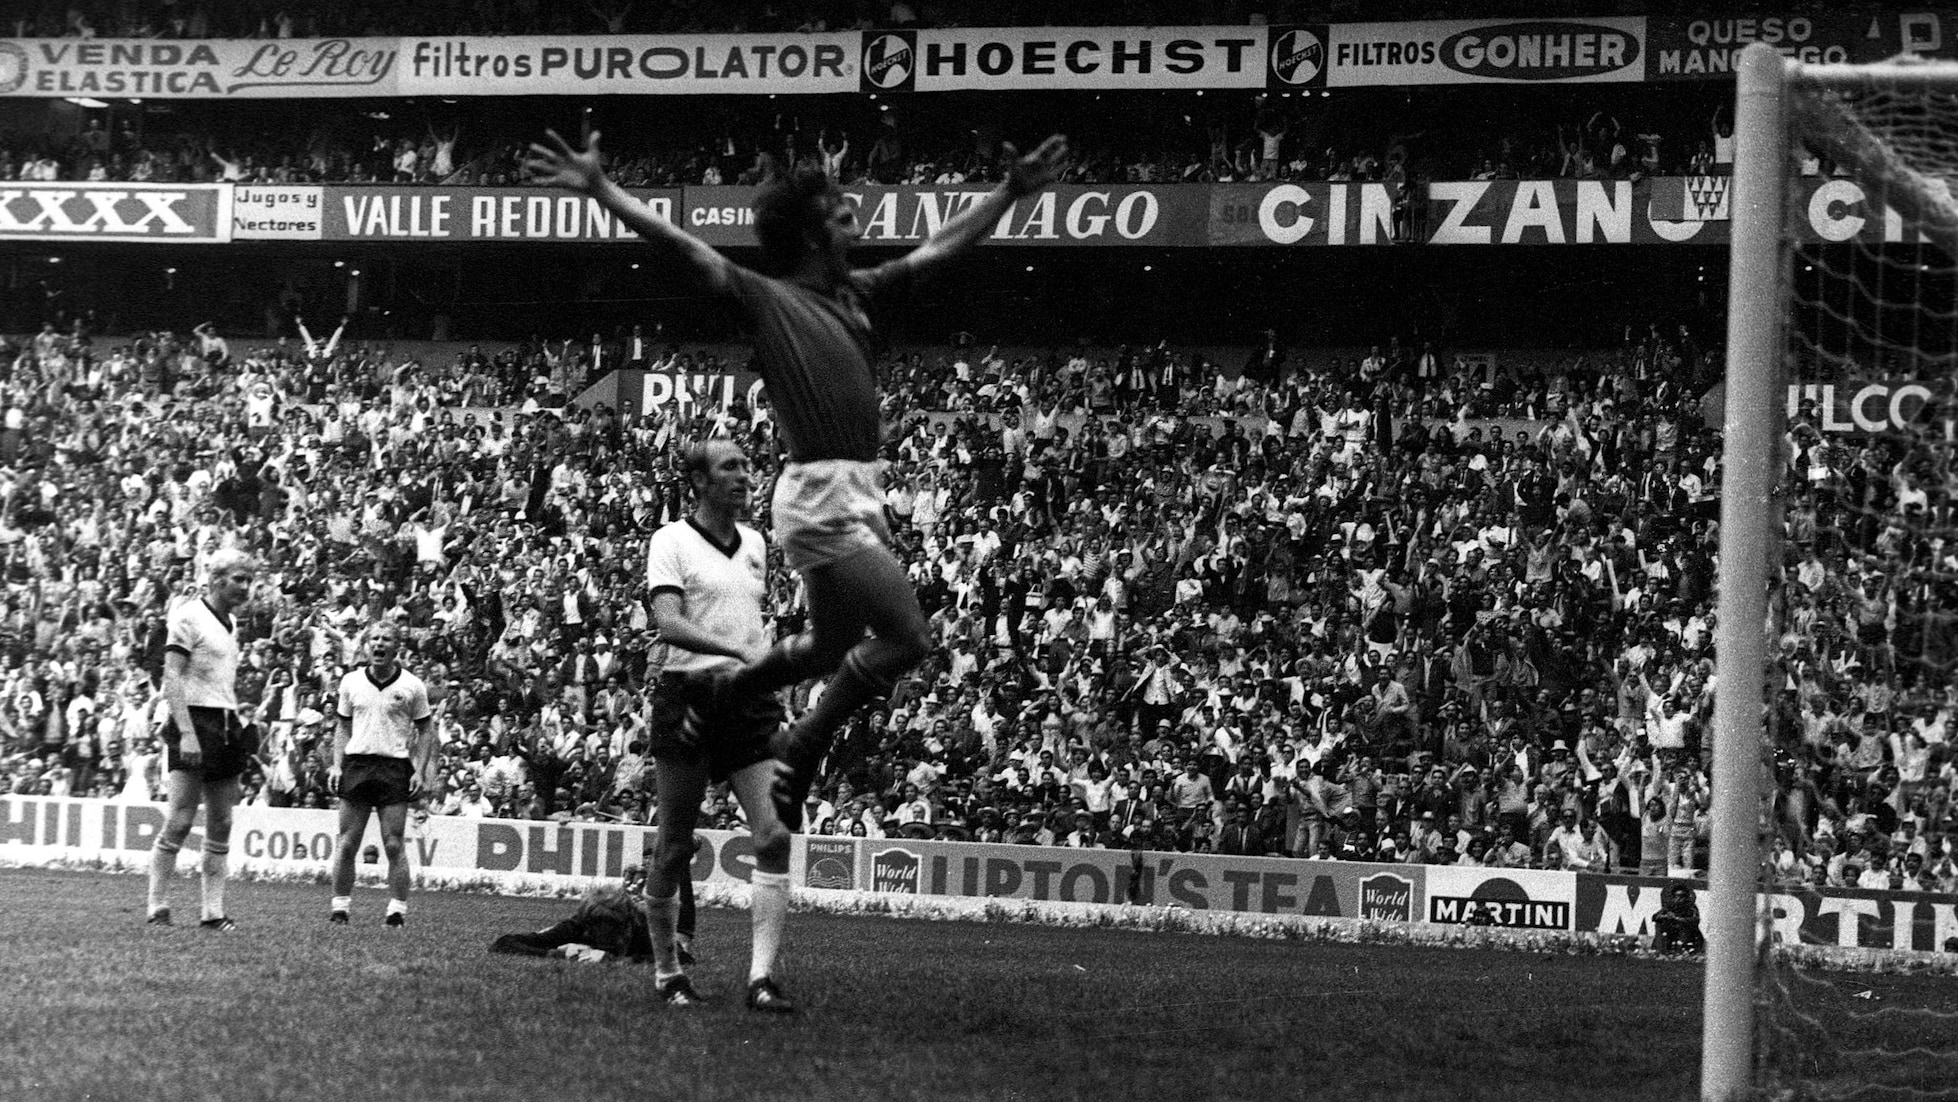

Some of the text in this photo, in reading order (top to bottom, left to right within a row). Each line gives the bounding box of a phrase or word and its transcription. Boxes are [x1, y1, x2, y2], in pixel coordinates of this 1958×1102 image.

[1688, 17, 1812, 46] QUESO
[40, 43, 221, 66] VENDA
[233, 39, 397, 84] Le Roy
[413, 42, 846, 79] filtros PUROLATOR
[926, 38, 1255, 76] HOECHST
[1337, 33, 1626, 68] FILTROS GONHER
[36, 71, 222, 94] ELASTICA
[237, 190, 301, 208] Jugos
[234, 218, 317, 231] Nectares
[344, 195, 450, 237] VALLE
[810, 843, 853, 854] PHILIPS
[876, 864, 917, 880] World
[1365, 889, 1408, 907] World
